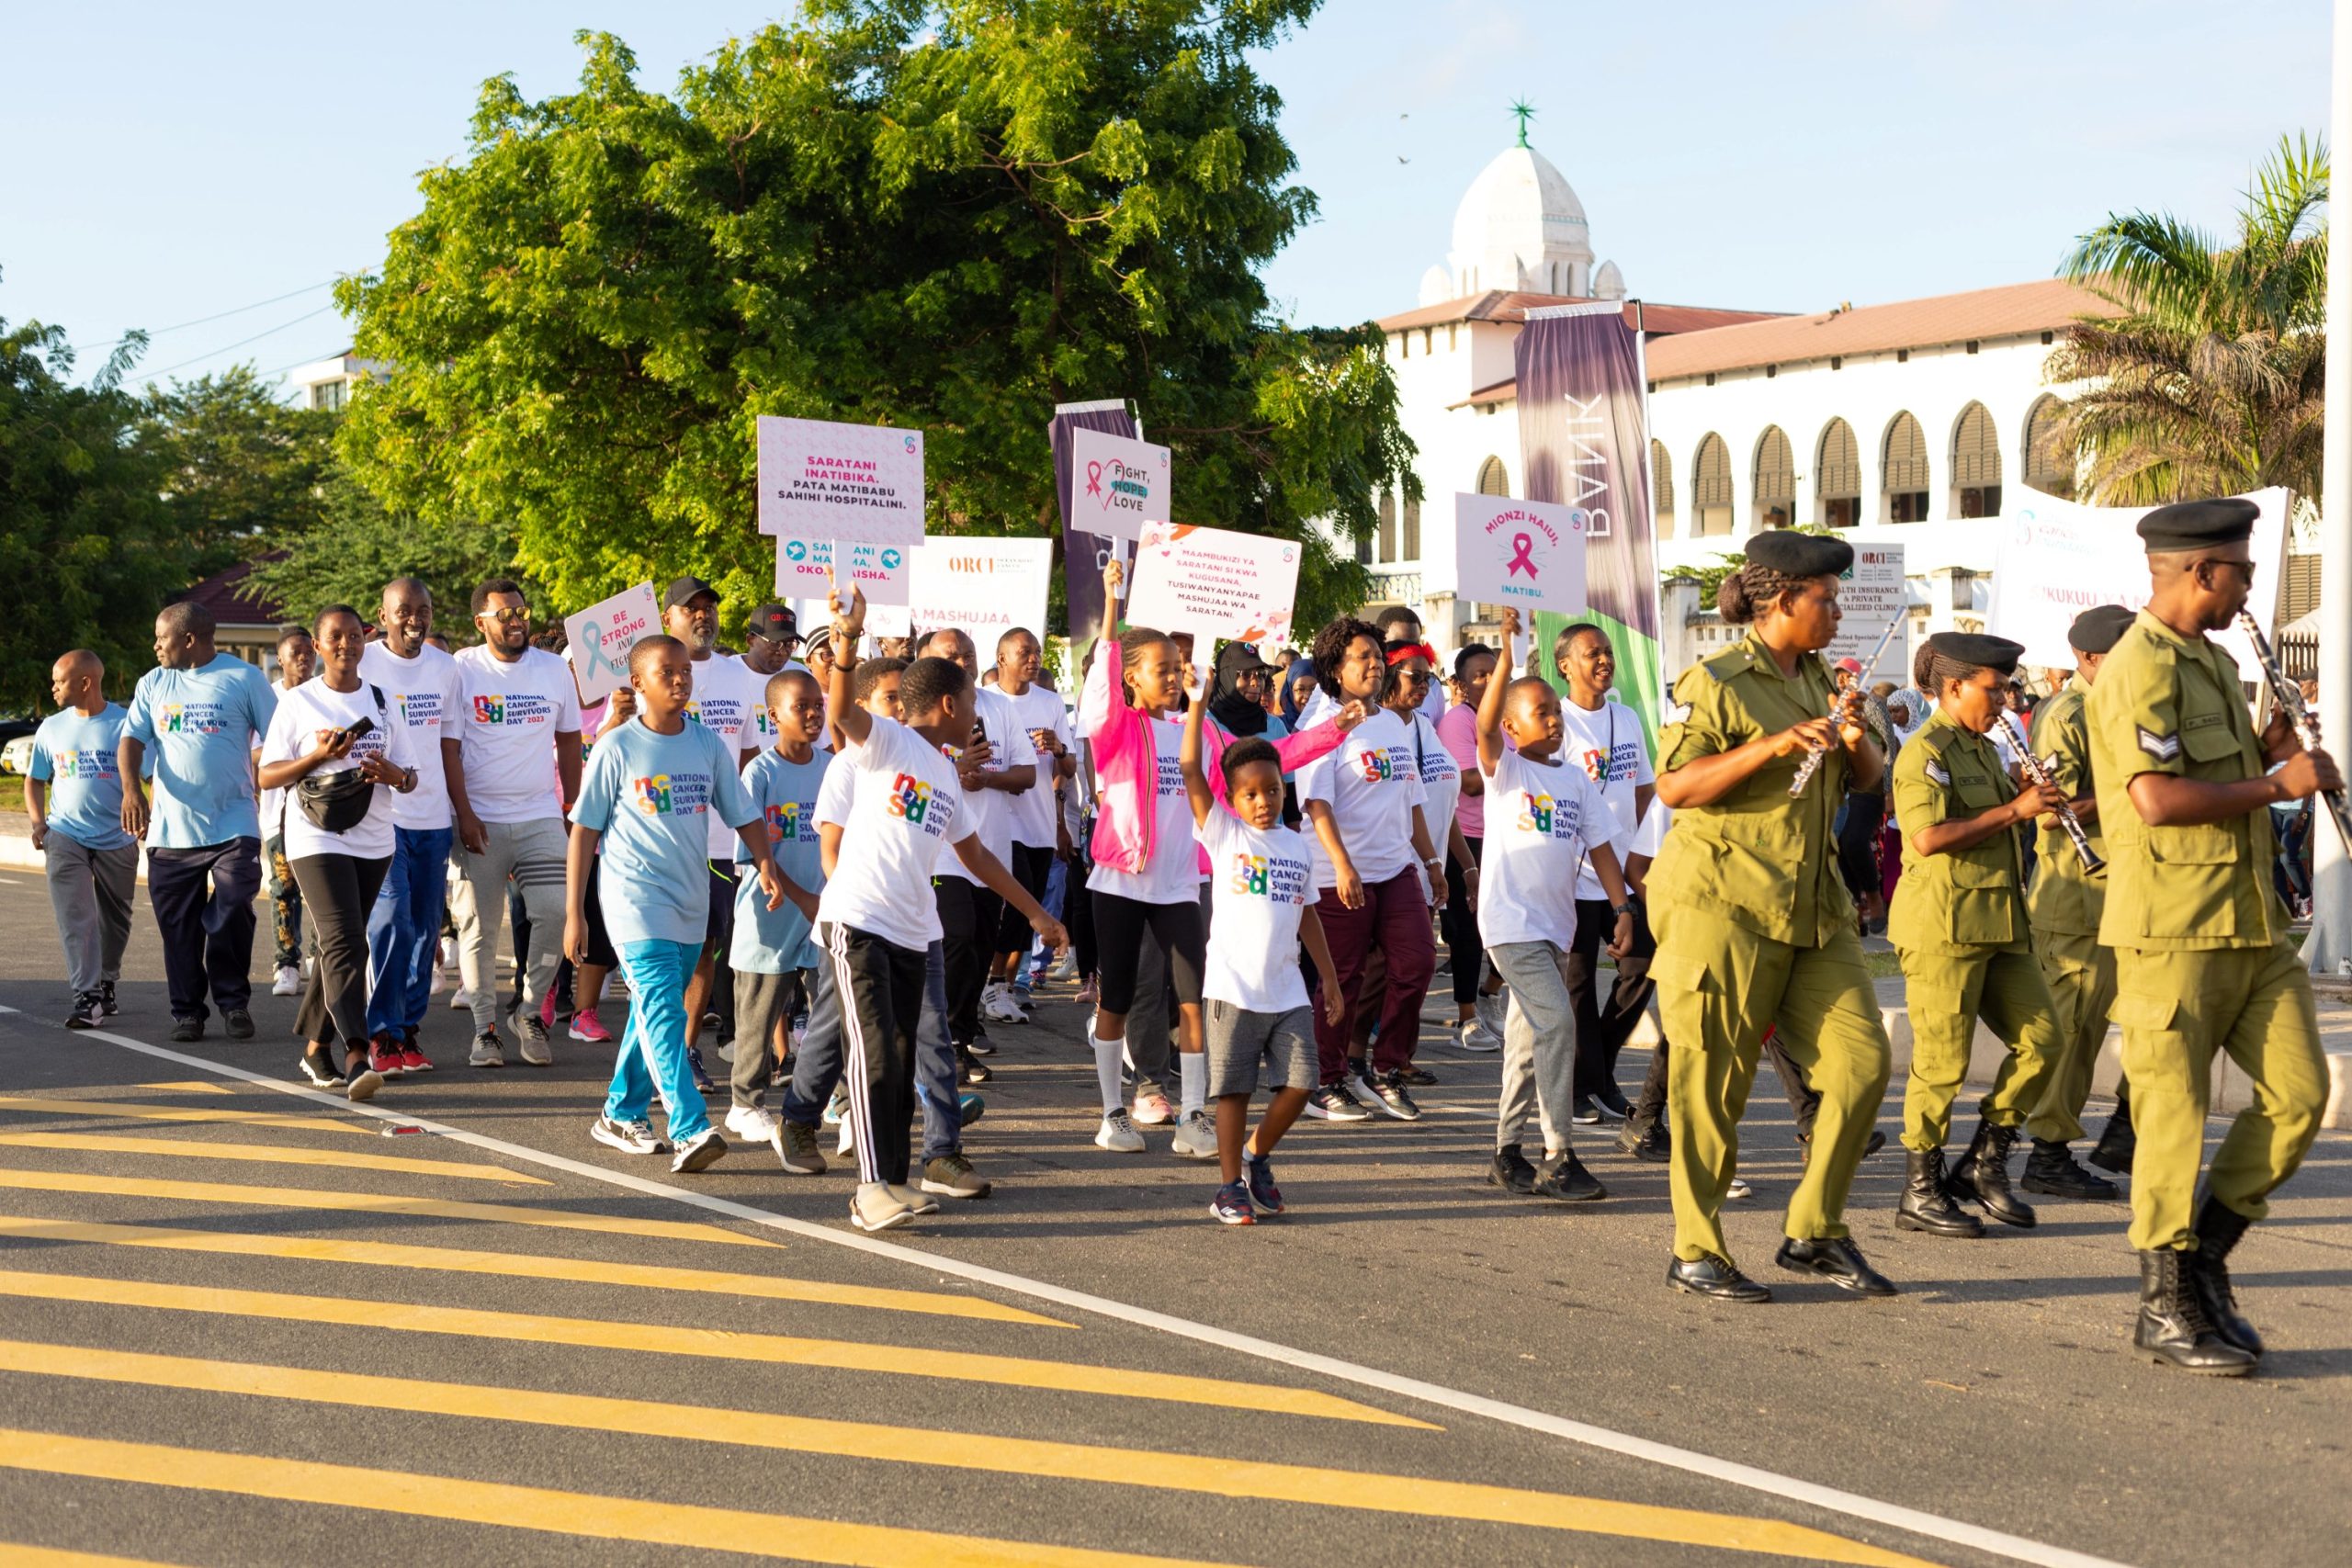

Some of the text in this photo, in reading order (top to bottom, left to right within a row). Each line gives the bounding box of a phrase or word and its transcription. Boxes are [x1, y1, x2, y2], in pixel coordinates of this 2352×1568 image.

[808, 457, 876, 470] SARATANI
[805, 468, 879, 483] INATIBIKA.
[1114, 465, 1150, 484] FIGHT,
[794, 480, 895, 497] PATA MATIBABU
[1114, 480, 1148, 499] HOPE,
[778, 491, 907, 509] SAHIHI HOSPITALINI.
[1114, 496, 1143, 512] LOVE
[1486, 511, 1525, 535] MIONZI
[1182, 549, 1255, 567] MAAMBUKIZI YA
[1862, 552, 1885, 565] ORCI
[1176, 559, 1223, 571] SARATANI
[1237, 569, 1258, 578] KWA
[1189, 573, 1242, 587] KUGUSANA,
[1501, 585, 1544, 599] INATIBU.
[1178, 592, 1247, 610] MASHUJAA WA
[613, 610, 628, 625] BE
[922, 609, 1011, 626] MASHUJAA
[1186, 605, 1235, 619] SARATANI.
[602, 618, 646, 646] STRONG
[507, 707, 551, 717] SURVIVORS
[673, 785, 707, 794] CANCER
[933, 788, 955, 807] NATION
[1556, 830, 1573, 840] DAY
